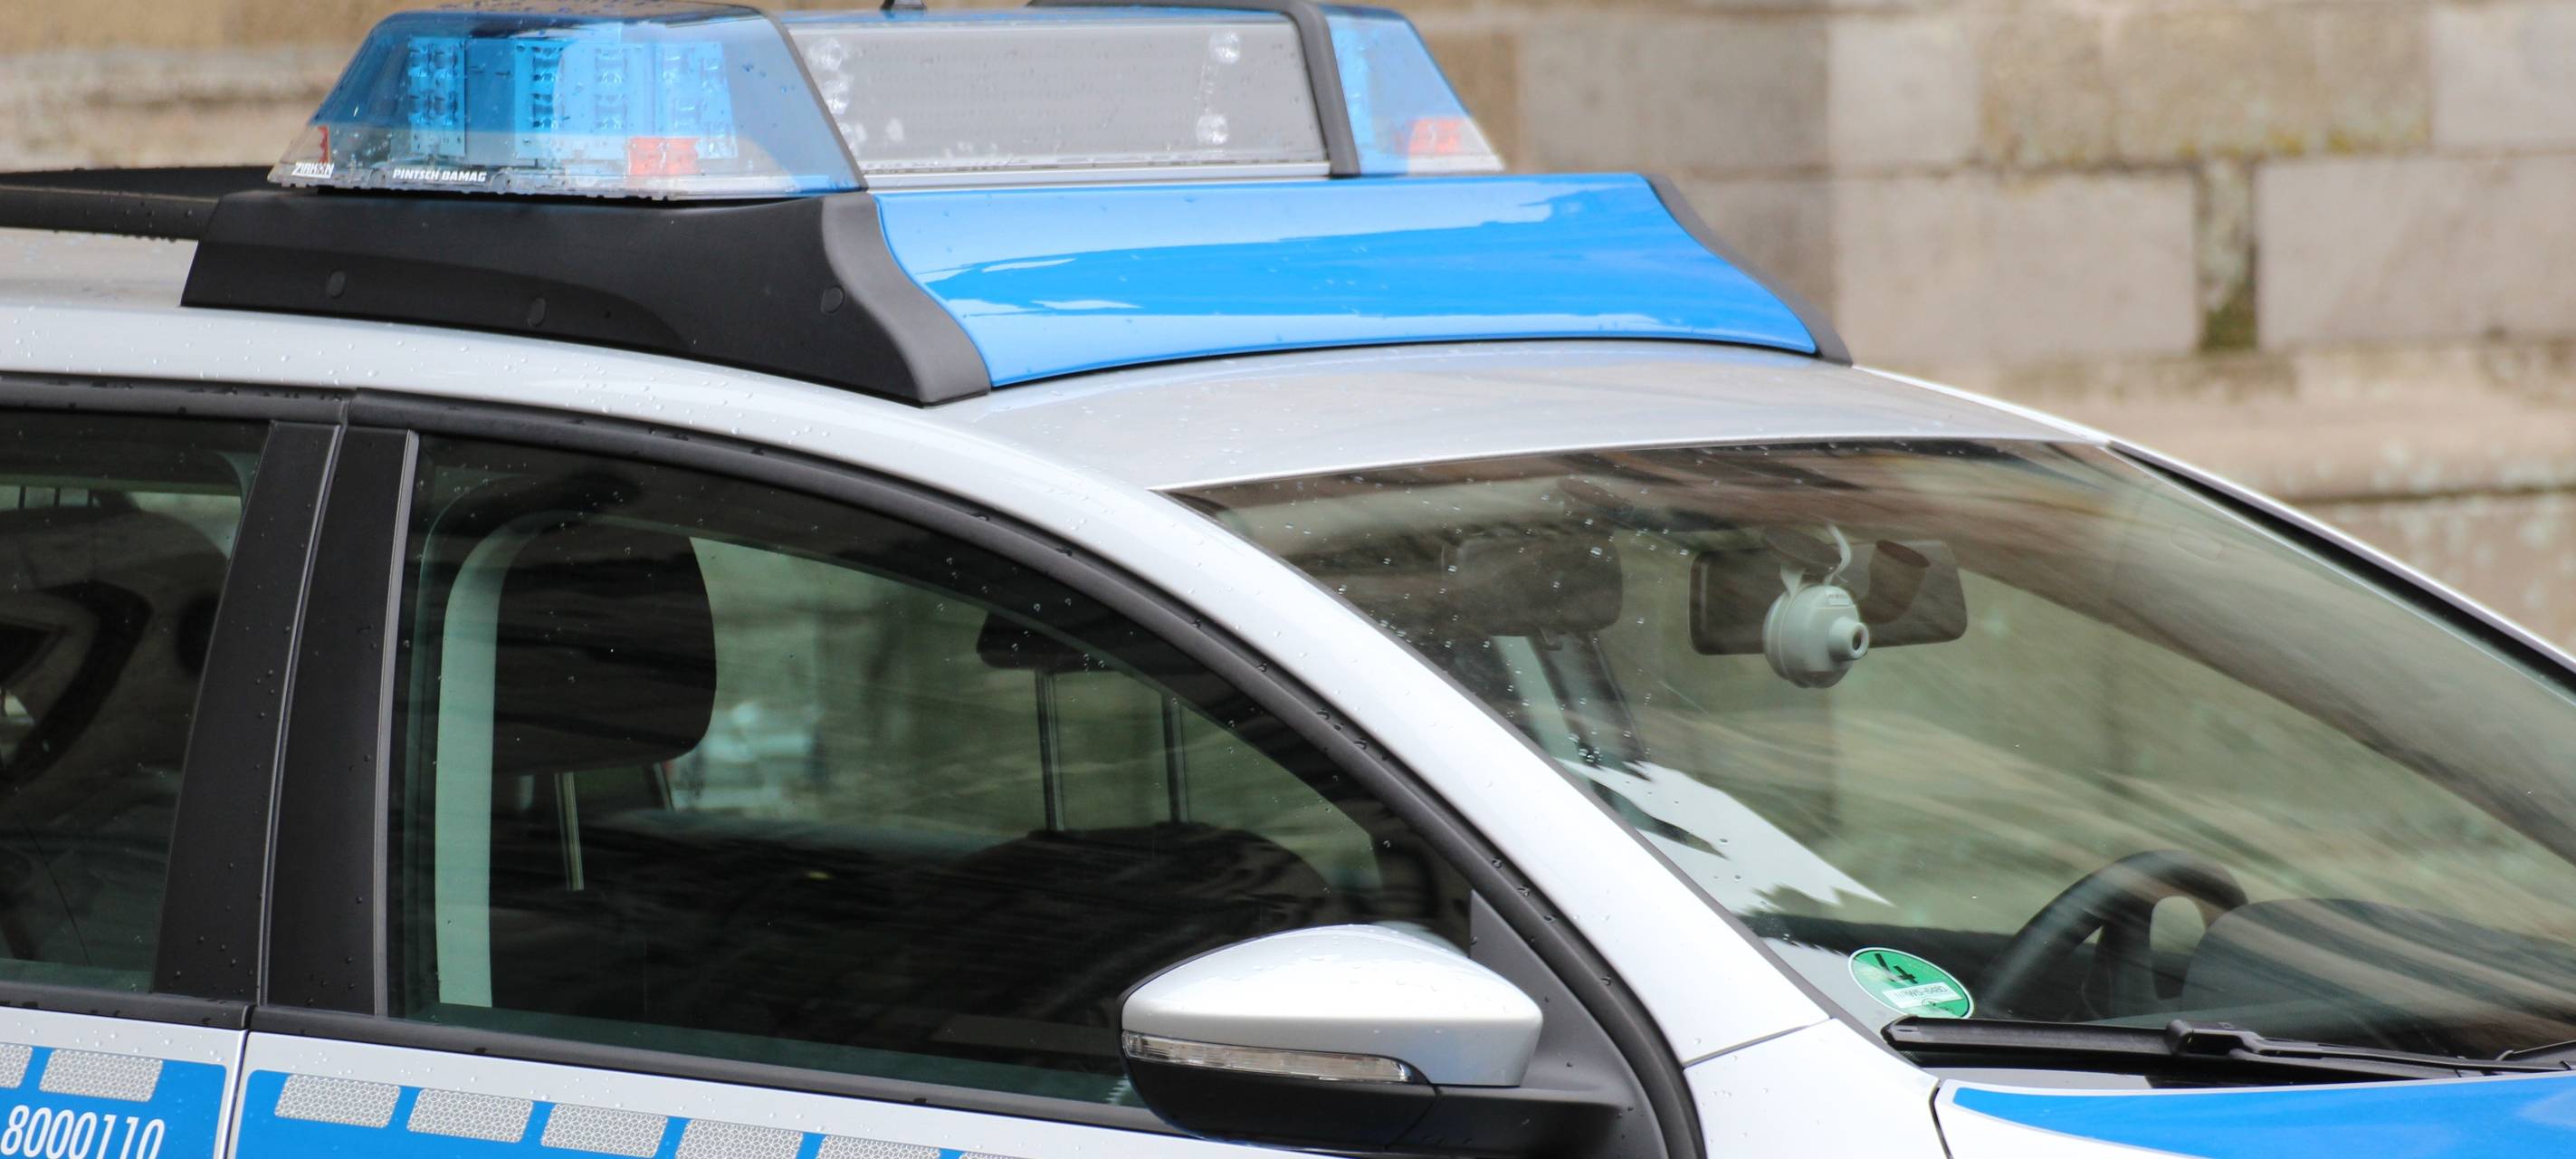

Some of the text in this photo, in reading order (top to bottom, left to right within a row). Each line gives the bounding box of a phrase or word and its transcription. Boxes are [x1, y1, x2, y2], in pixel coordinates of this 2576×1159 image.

[393, 168, 487, 182] PINTSCH BAMAG
[1874, 953, 1918, 984] 4
[0, 1105, 166, 1159] 8000110
